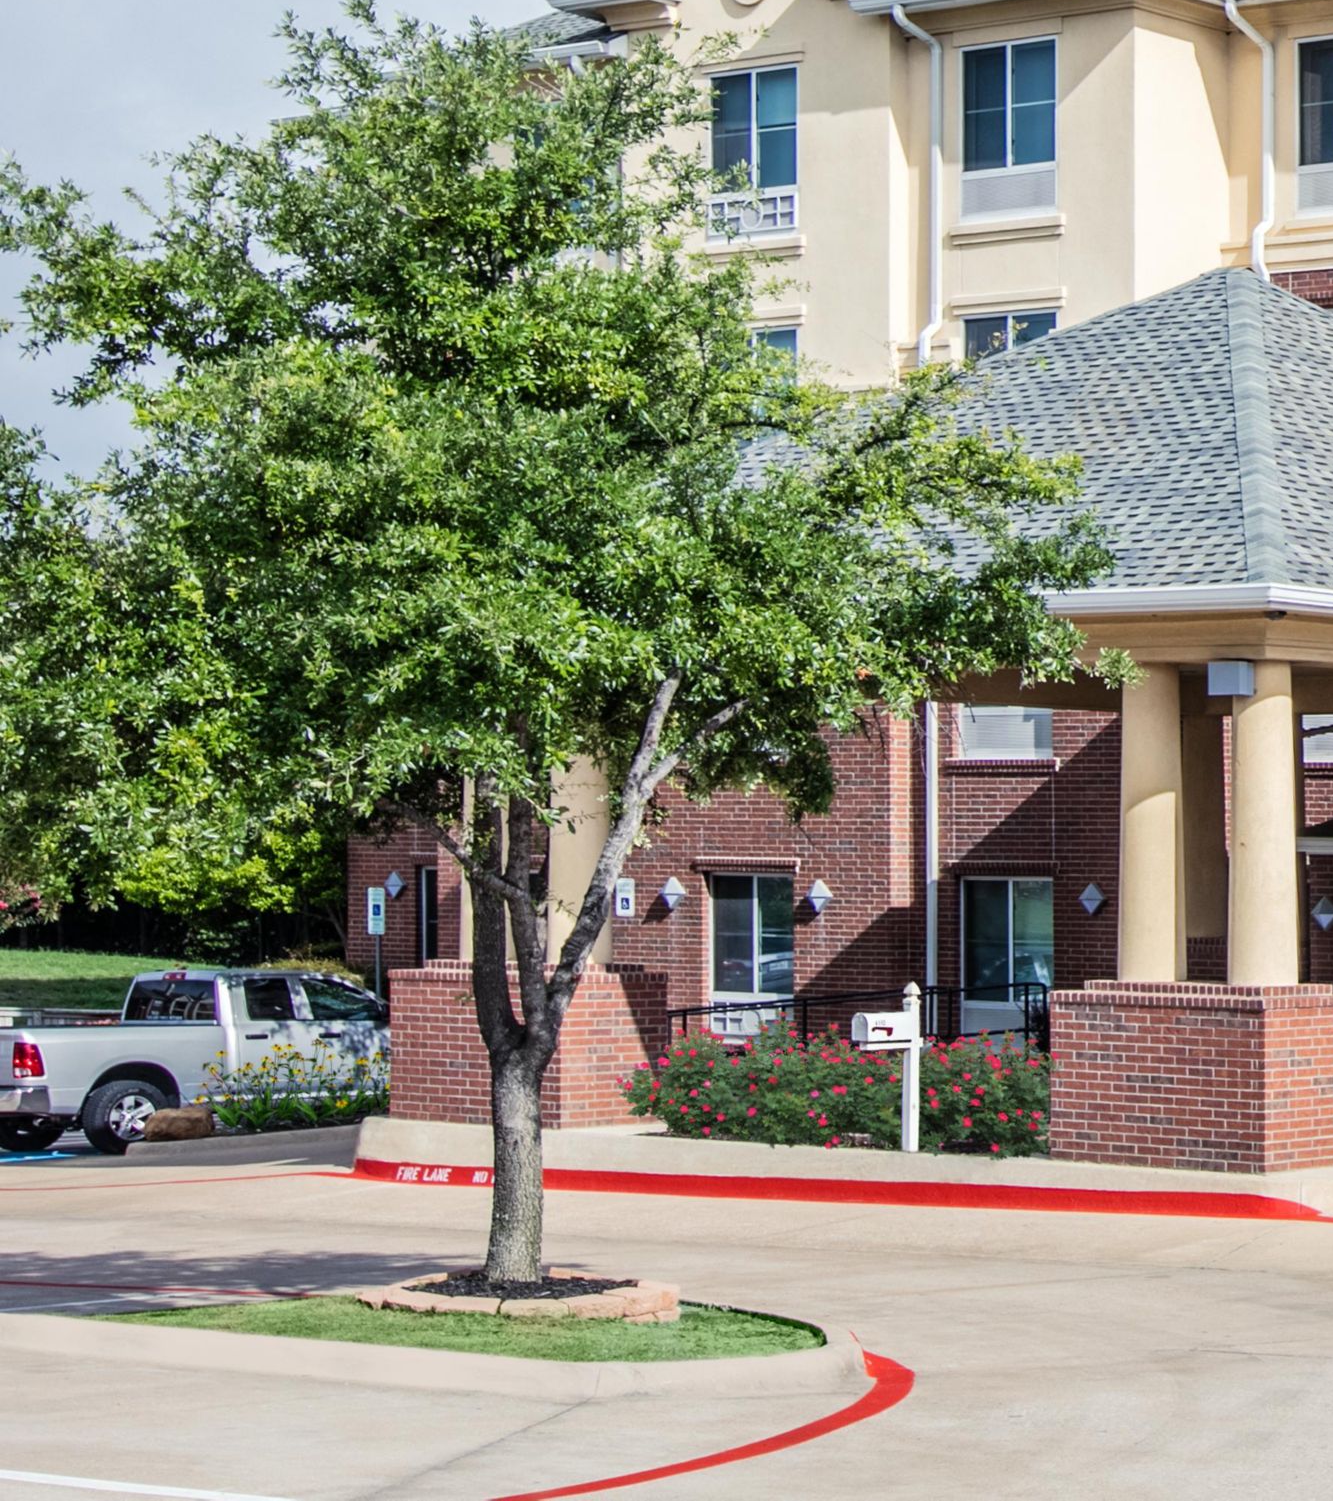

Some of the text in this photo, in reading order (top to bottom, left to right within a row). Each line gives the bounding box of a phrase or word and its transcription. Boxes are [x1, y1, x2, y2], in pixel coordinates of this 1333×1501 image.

[396, 1166, 421, 1181] FIRE
[423, 1167, 452, 1182] LANE
[472, 1171, 489, 1184] NO
